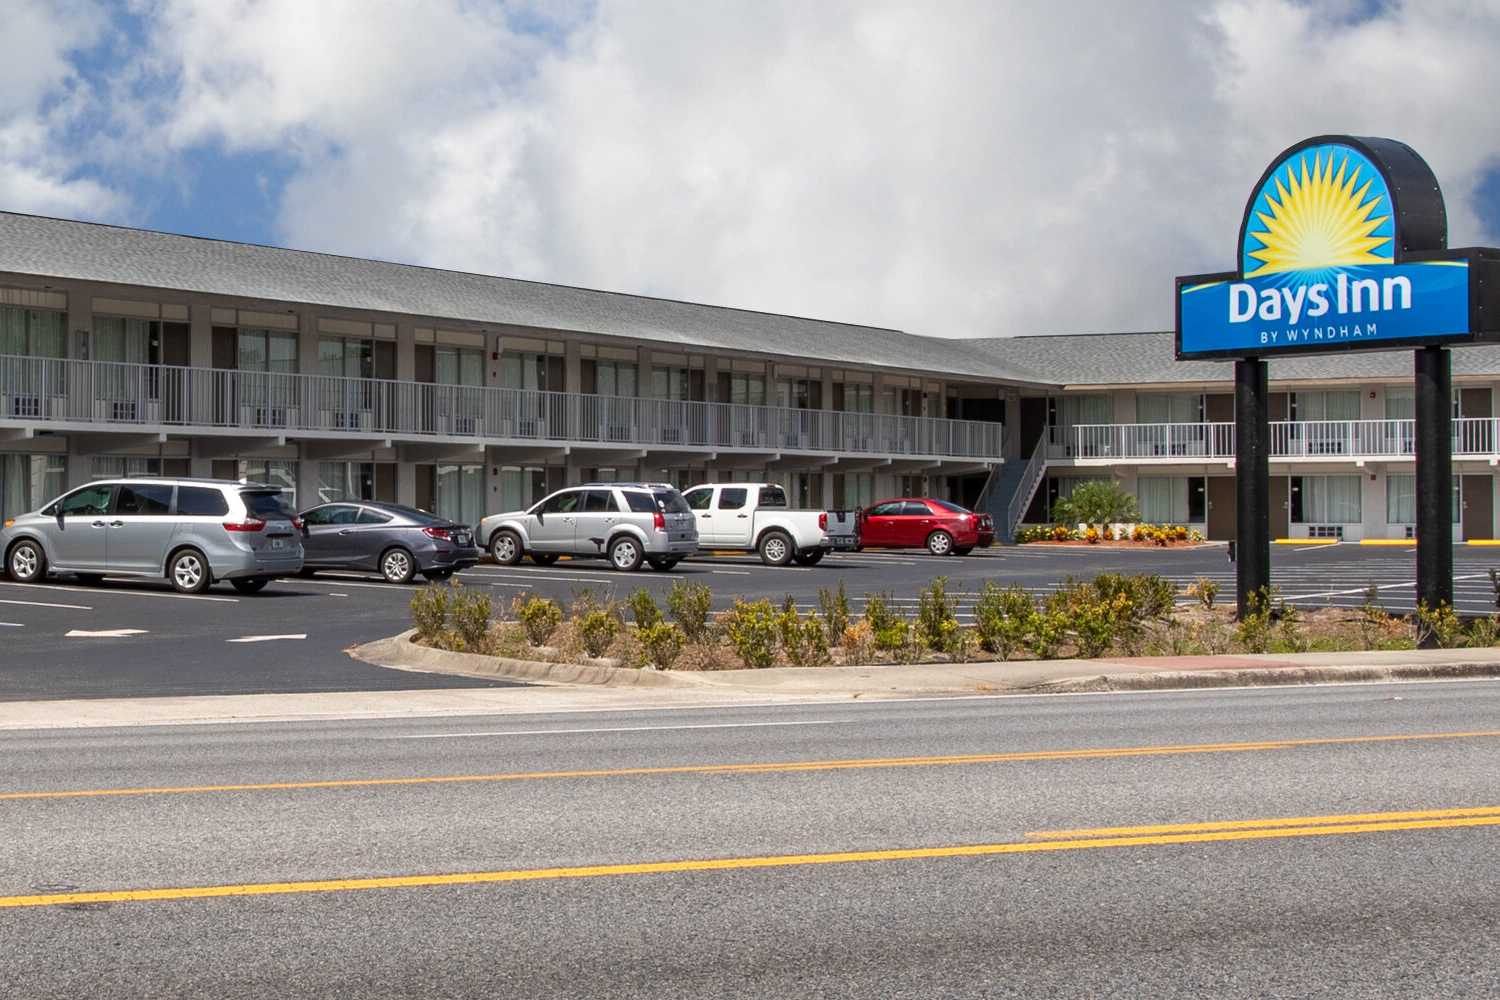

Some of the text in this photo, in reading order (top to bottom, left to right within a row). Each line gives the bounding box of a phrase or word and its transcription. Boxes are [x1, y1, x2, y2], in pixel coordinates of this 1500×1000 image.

[1229, 273, 1412, 326] Days Inn
[1260, 323, 1378, 344] BY WYNDHAM
